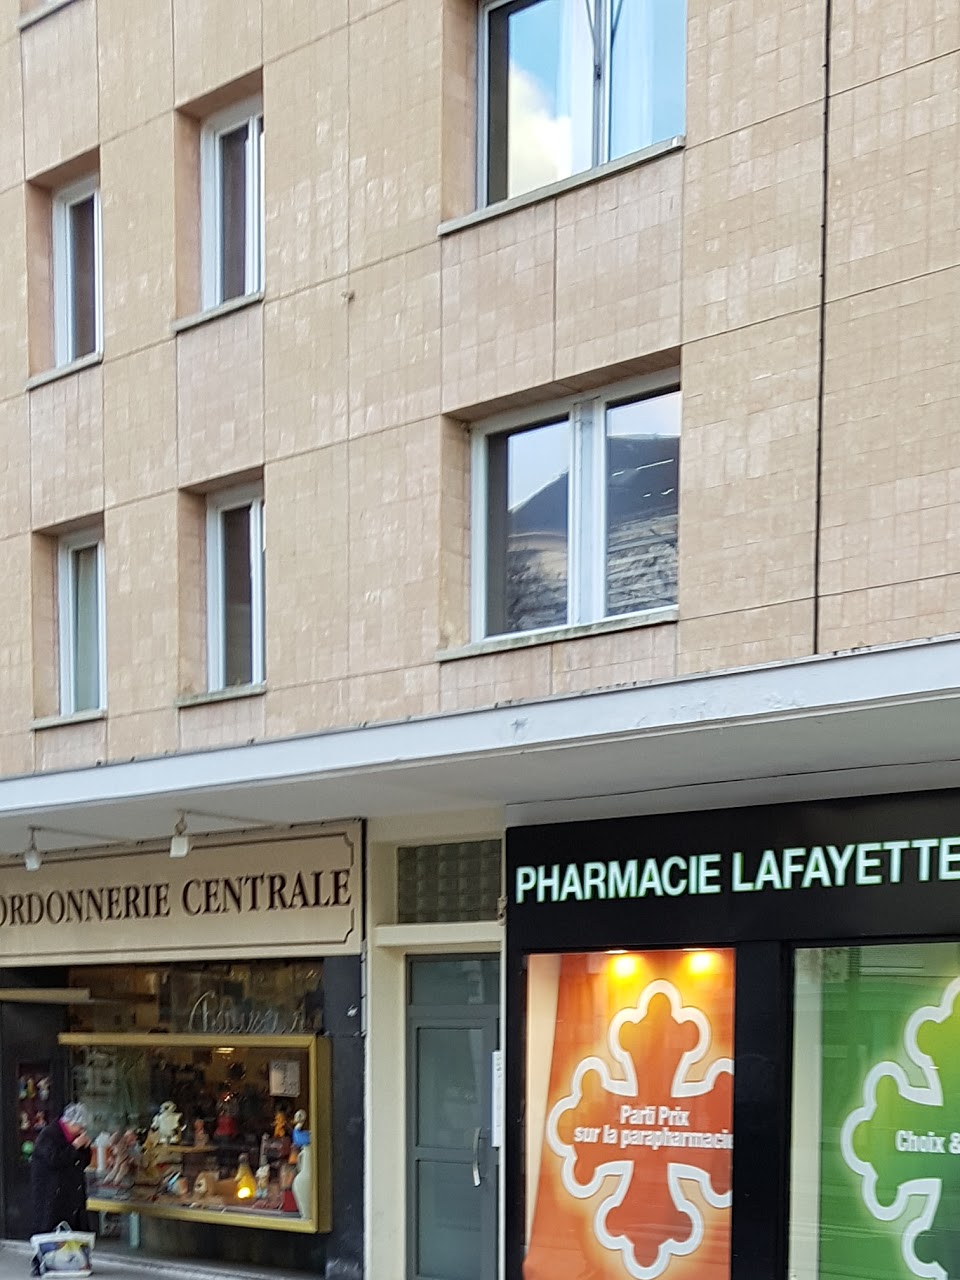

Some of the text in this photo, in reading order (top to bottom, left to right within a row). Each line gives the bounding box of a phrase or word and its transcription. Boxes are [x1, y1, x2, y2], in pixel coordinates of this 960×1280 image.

[514, 851, 722, 905] PHARMACIE
[182, 868, 353, 917] CENTRALE
[619, 1104, 691, 1127] Parti Prix
[573, 1126, 601, 1144] sur
[602, 1124, 618, 1145] la
[895, 1129, 947, 1154] Choix
